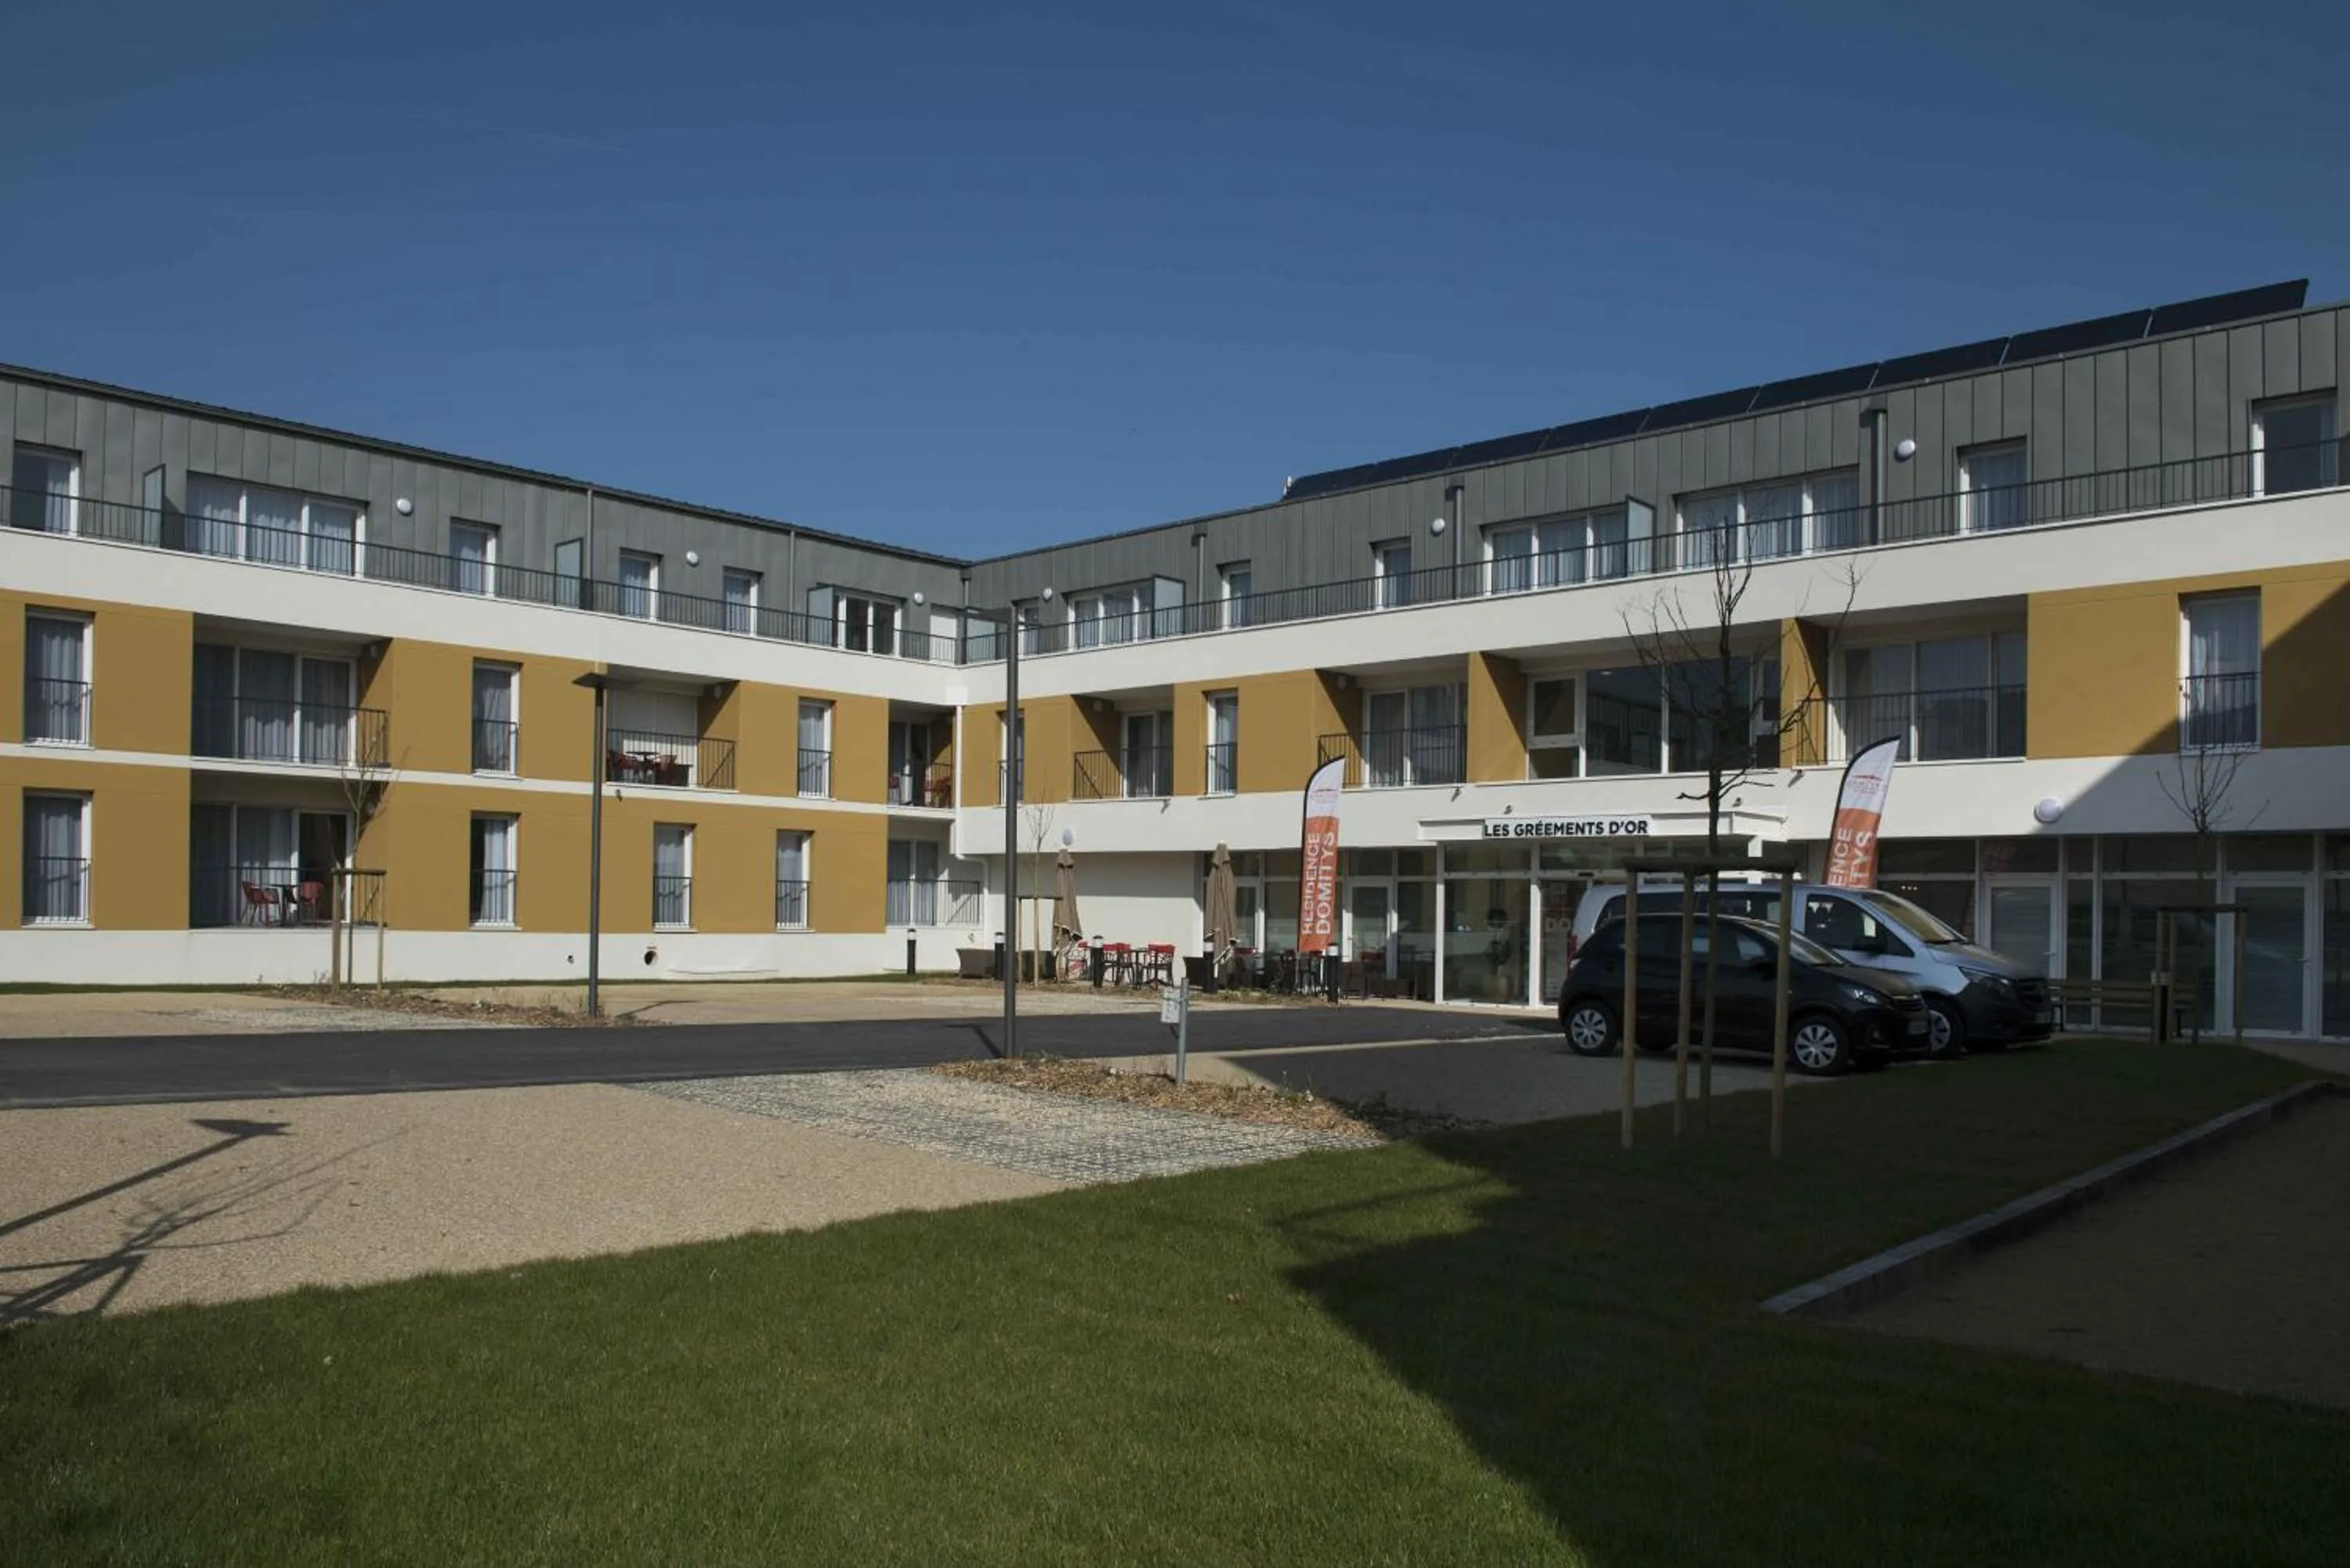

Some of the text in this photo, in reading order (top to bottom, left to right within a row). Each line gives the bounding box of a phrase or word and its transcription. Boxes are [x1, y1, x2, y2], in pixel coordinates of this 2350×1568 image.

[1484, 820, 1648, 837] LES GRÉEMENTS D'OR
[1828, 828, 1853, 886] ENCE
[1316, 832, 1334, 934] DOMITYS
[1546, 918, 1571, 931] DO
